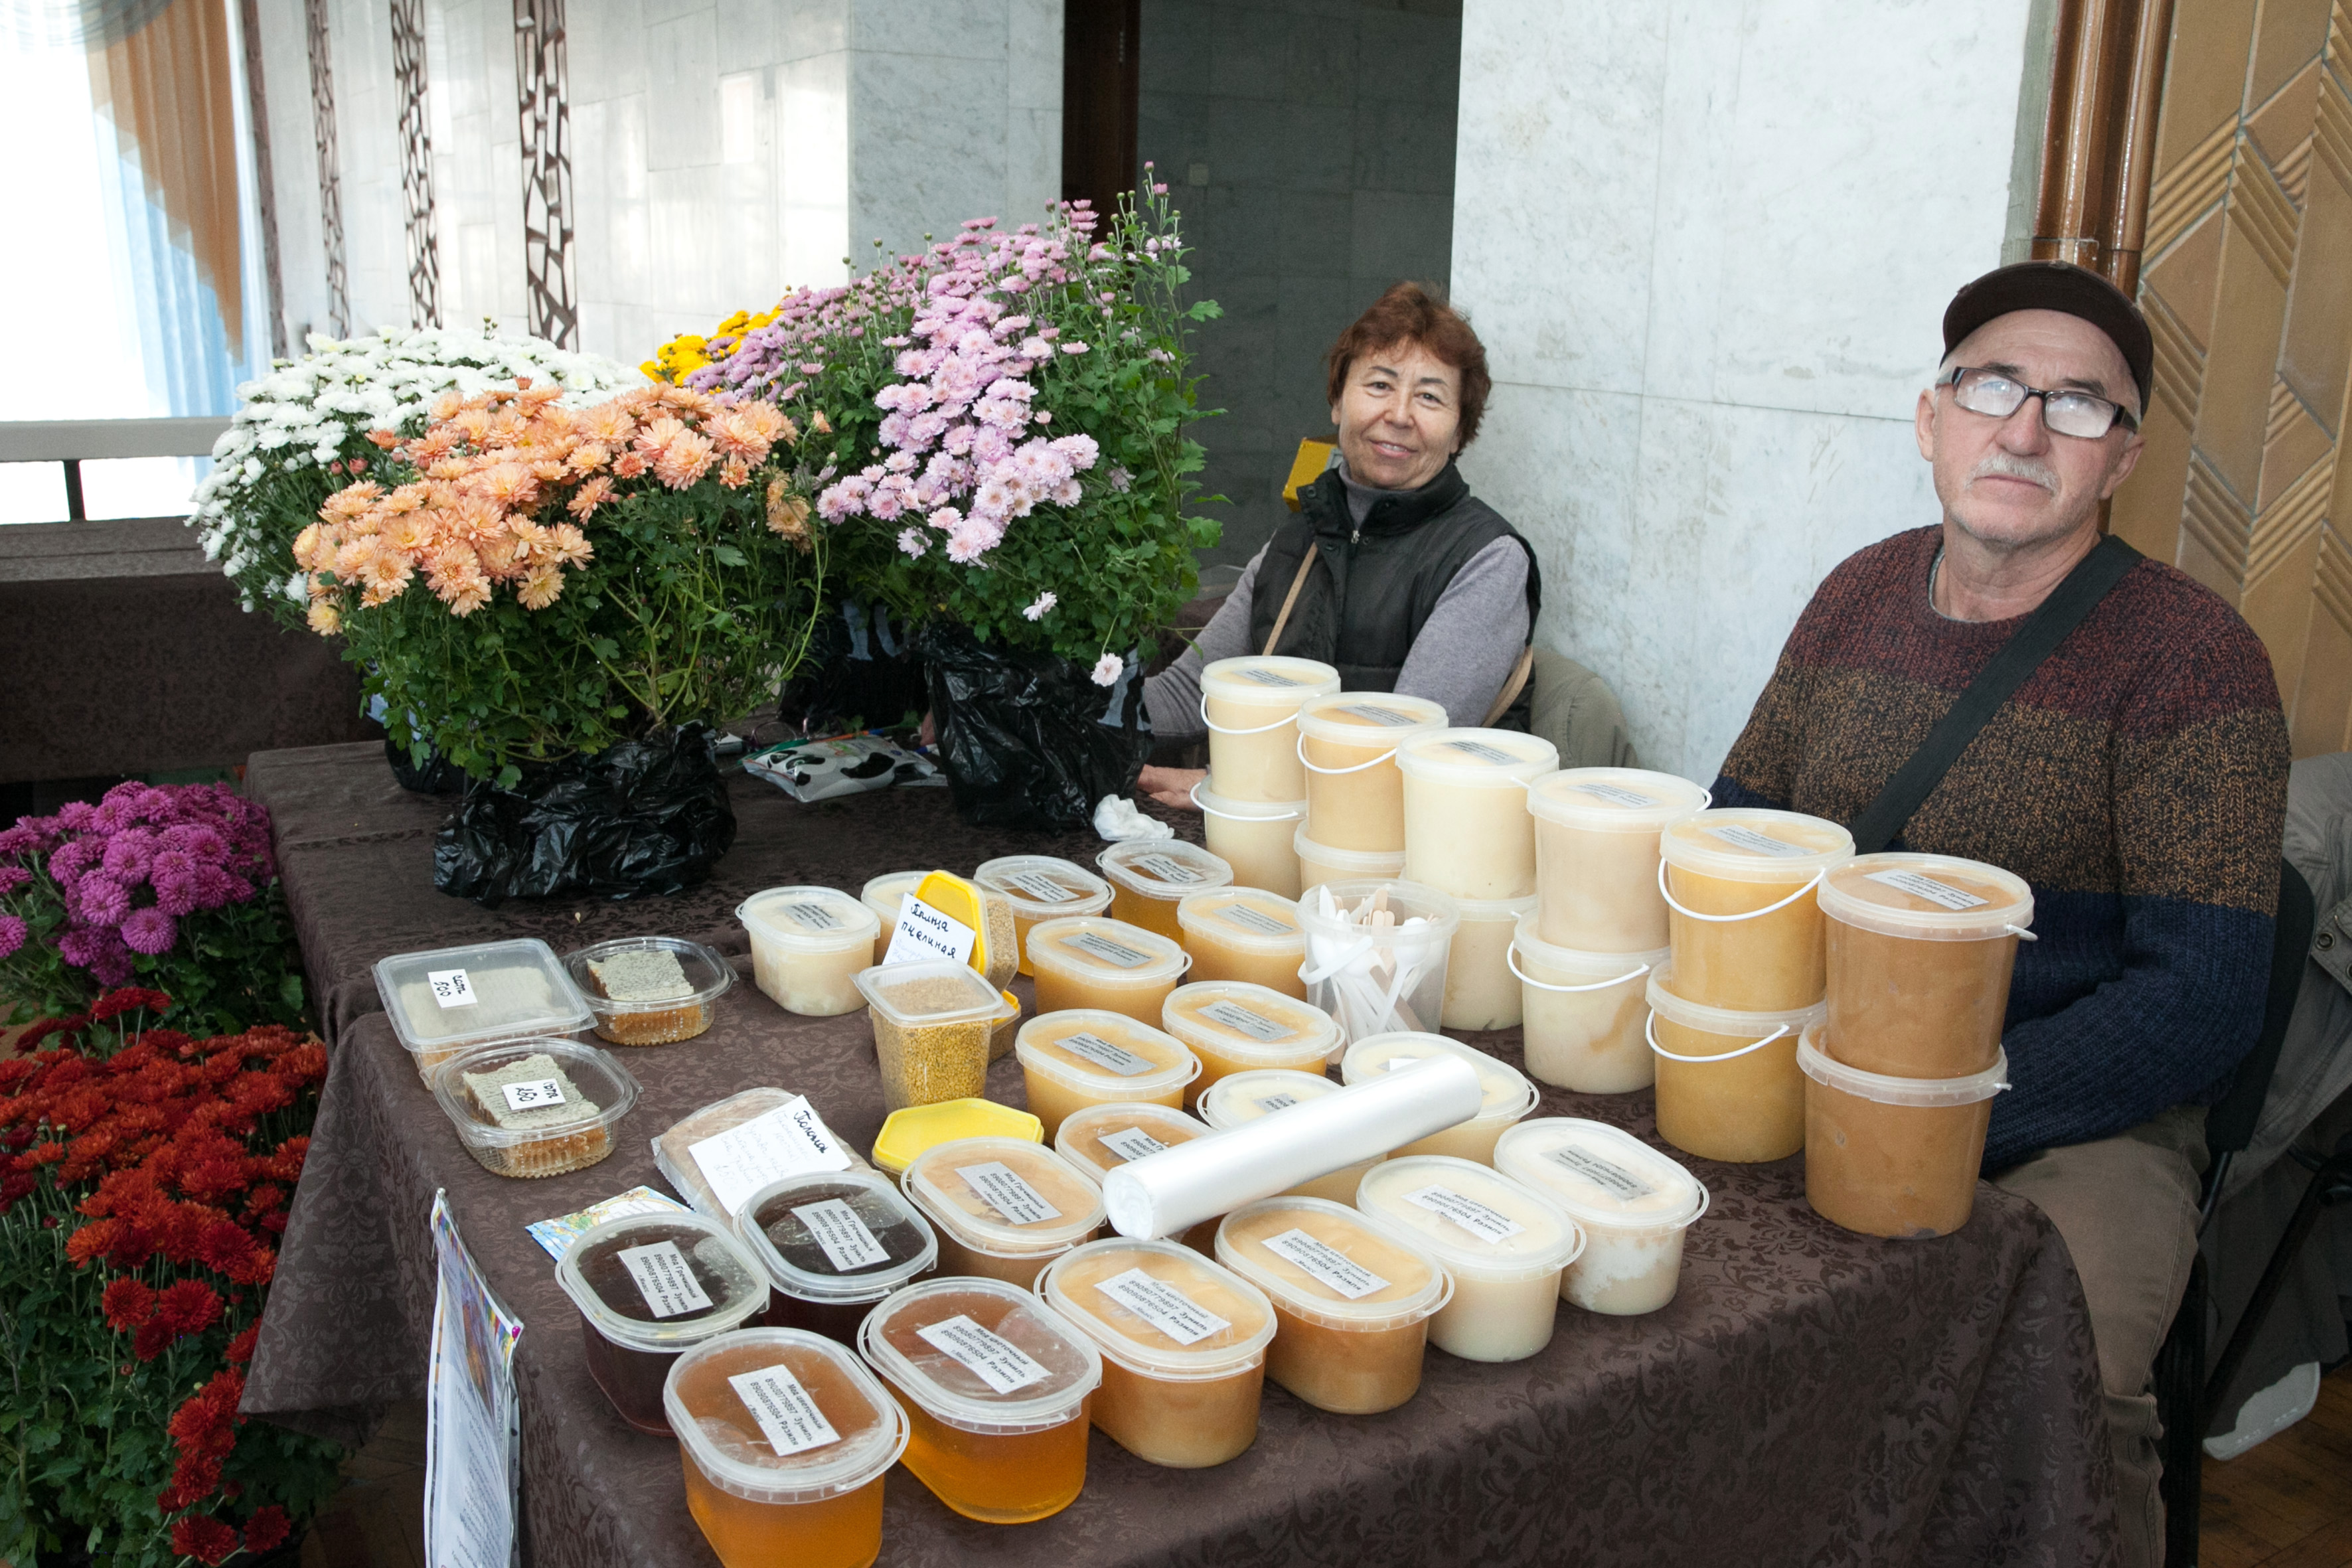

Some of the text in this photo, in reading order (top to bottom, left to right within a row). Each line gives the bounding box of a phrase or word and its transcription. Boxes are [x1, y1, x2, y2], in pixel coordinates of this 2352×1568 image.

[902, 921, 956, 959] пчелиная
[433, 982, 451, 996] 500
[1120, 1141, 1146, 1157] 8909087
[1130, 1138, 1156, 1154] 8908077
[1144, 1137, 1156, 1146] Мед
[979, 1175, 1032, 1222] 89090876504 Разиля
[990, 1172, 1042, 1219] 89080779897 Зуниль
[1004, 1172, 1045, 1210] Мед Гречишный
[1431, 1192, 1510, 1231] 89080779897 Зуниль
[1454, 1194, 1511, 1222] Мед цветочный
[809, 1227, 826, 1245] г.Миасс
[824, 1209, 866, 1263] 89080779897 Зуниль
[840, 1210, 874, 1252] Мед Гречишный
[1422, 1195, 1502, 1235] 89090876504 Разиля
[811, 1212, 854, 1266] 89090876504 Разиля
[1314, 1241, 1372, 1277] Мед цветочный
[638, 1275, 650, 1293] г.Миасс
[653, 1253, 688, 1311] 89080779897 Зуниль
[669, 1253, 698, 1298] Мед Гречишный
[1282, 1240, 1362, 1291] 89090876504 Разиля
[1291, 1237, 1370, 1287] 89080779897 Зуниль
[640, 1256, 676, 1315] 89090876504 Разиля
[1129, 1280, 1208, 1331] 89080779897 Зуниль
[1152, 1281, 1208, 1318] Мед цветочный
[1118, 1285, 1199, 1336] 89090876504 Разиля
[941, 1330, 1015, 1383] 89090876504 Разиля
[953, 1325, 1025, 1378] 89080779897 Зуниль
[975, 1328, 1028, 1365] Мед цветочный
[750, 1381, 799, 1445] 89090876504 Разиля
[765, 1377, 812, 1441] 89080779897 Зуниль
[787, 1383, 823, 1429] Мед цветочный
